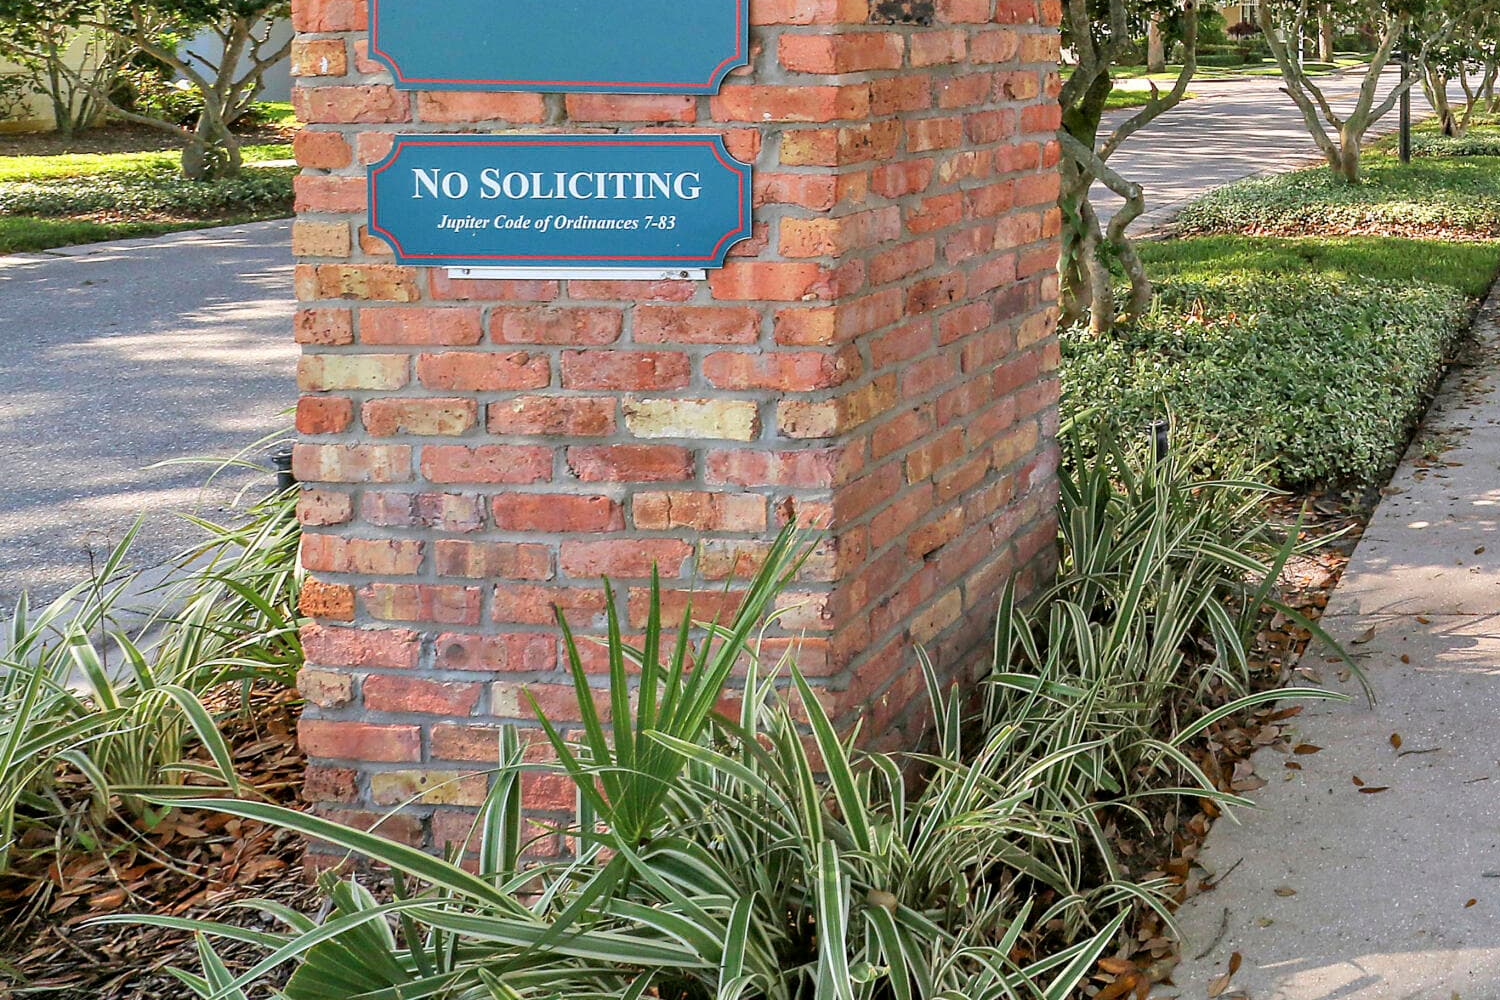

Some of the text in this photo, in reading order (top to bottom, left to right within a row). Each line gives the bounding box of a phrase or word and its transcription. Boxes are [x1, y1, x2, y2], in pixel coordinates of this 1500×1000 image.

[411, 168, 702, 200] NO SOLICITING
[437, 214, 677, 233] Jupiter Code of Ordinances 7-83
